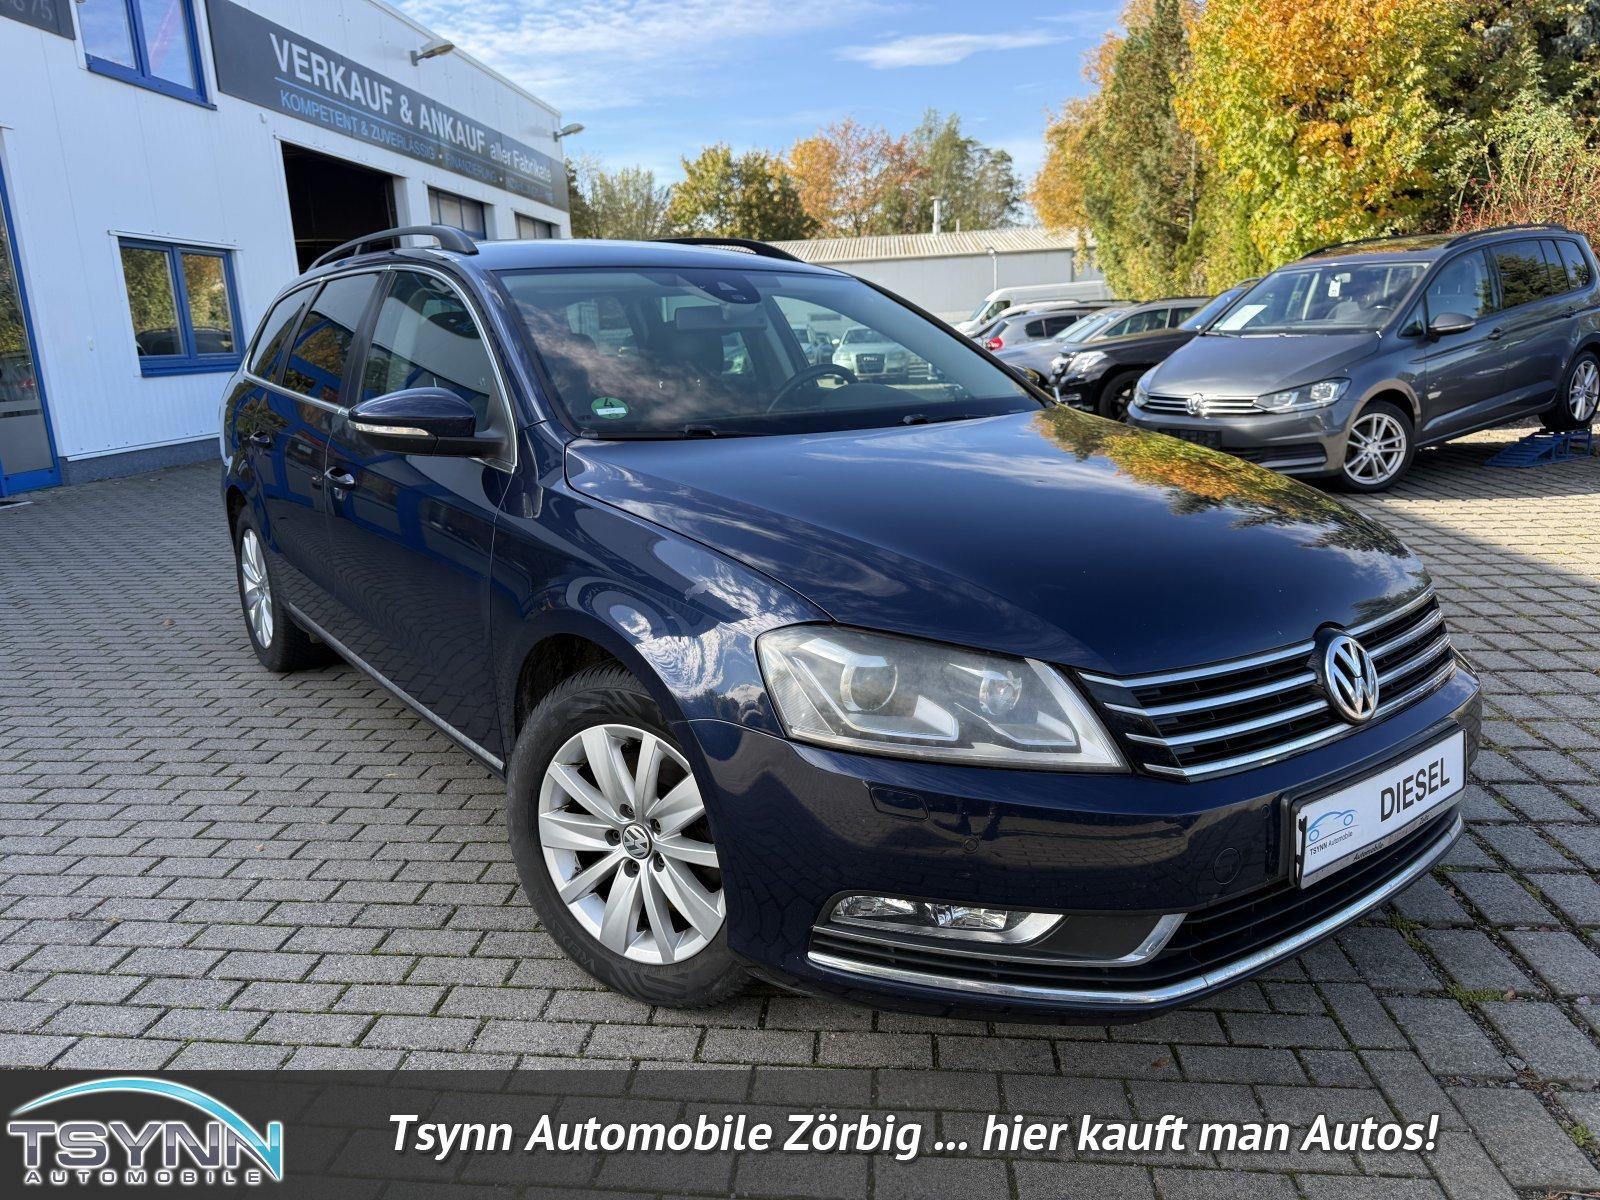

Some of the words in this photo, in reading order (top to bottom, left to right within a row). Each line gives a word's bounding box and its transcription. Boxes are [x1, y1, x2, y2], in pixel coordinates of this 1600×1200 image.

[269, 32, 393, 115] VERKAUF
[400, 94, 414, 126] &
[420, 103, 485, 154] ANKAUF
[280, 89, 358, 133] KOMPETENT
[360, 120, 369, 136] &
[603, 397, 615, 408] 4
[1380, 757, 1450, 823] DIESEL
[1310, 841, 1328, 856] TSYNN
